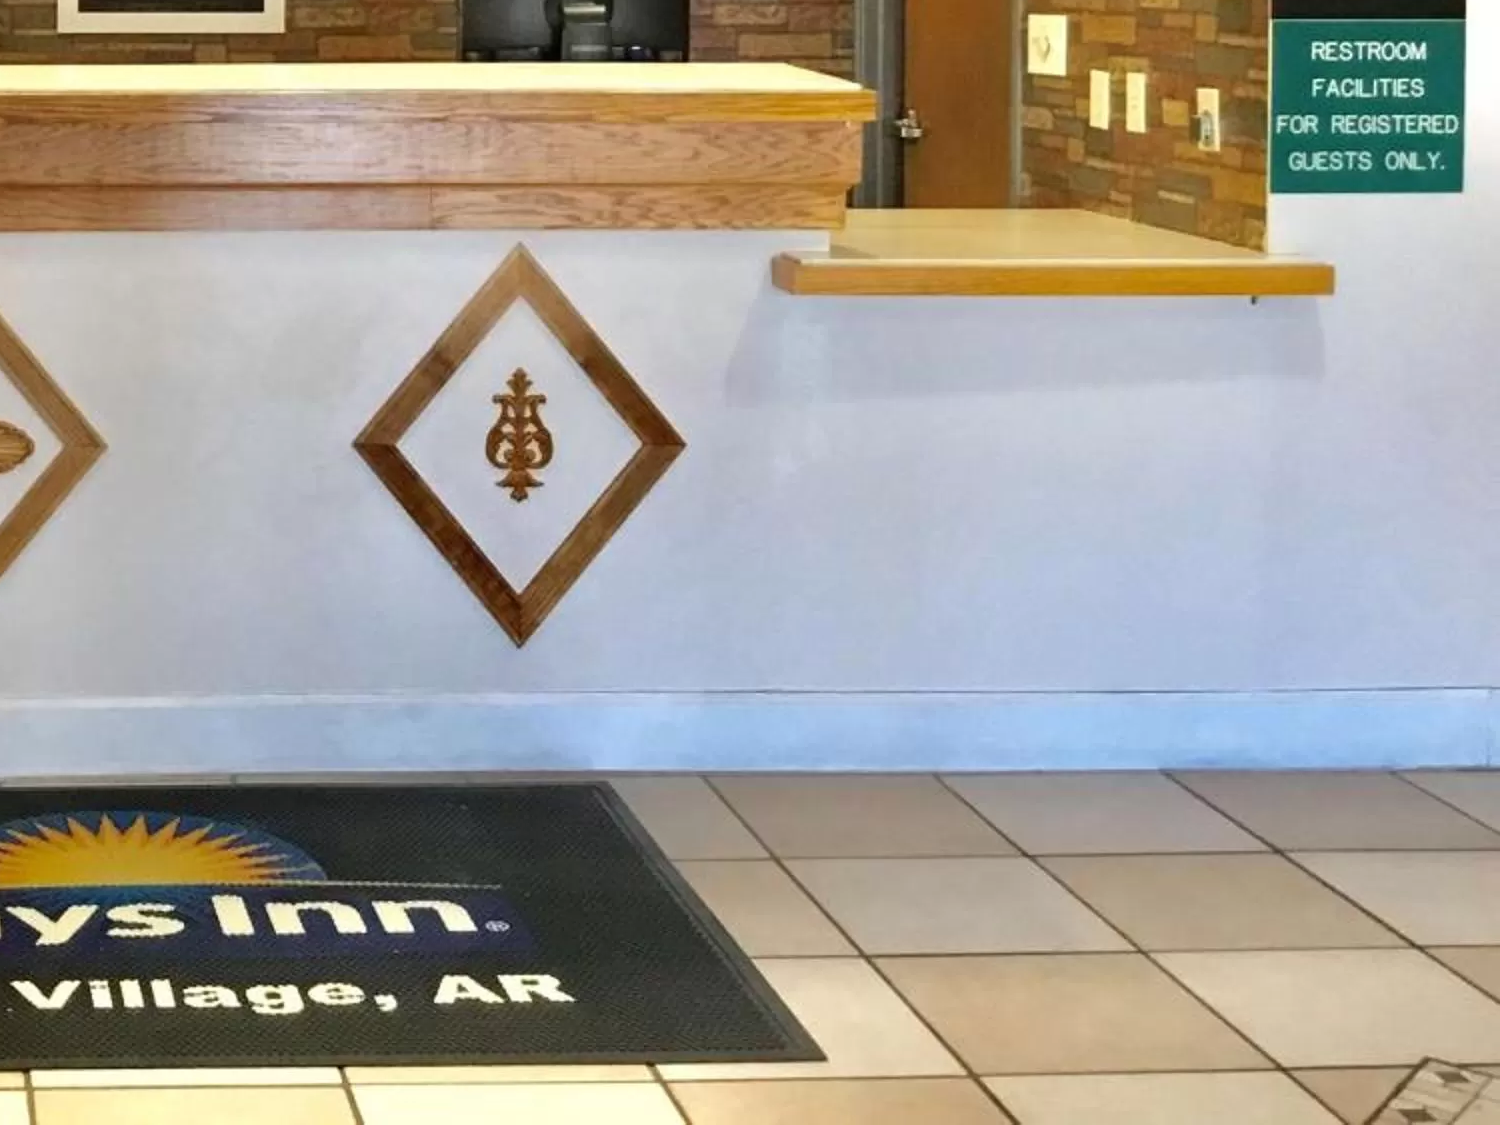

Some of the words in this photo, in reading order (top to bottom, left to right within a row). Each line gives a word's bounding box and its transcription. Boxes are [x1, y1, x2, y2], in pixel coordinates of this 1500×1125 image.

[1311, 41, 1428, 61] RESTROOM
[1311, 78, 1425, 98] FACILITIES
[1276, 114, 1319, 134] FOR
[1331, 114, 1459, 135] REGISTERED
[1288, 150, 1373, 171] GUESTS
[1385, 150, 1446, 171] ONLY.
[213, 894, 480, 937] Inn
[13, 978, 398, 1017] Village,
[433, 973, 576, 1006] AR
